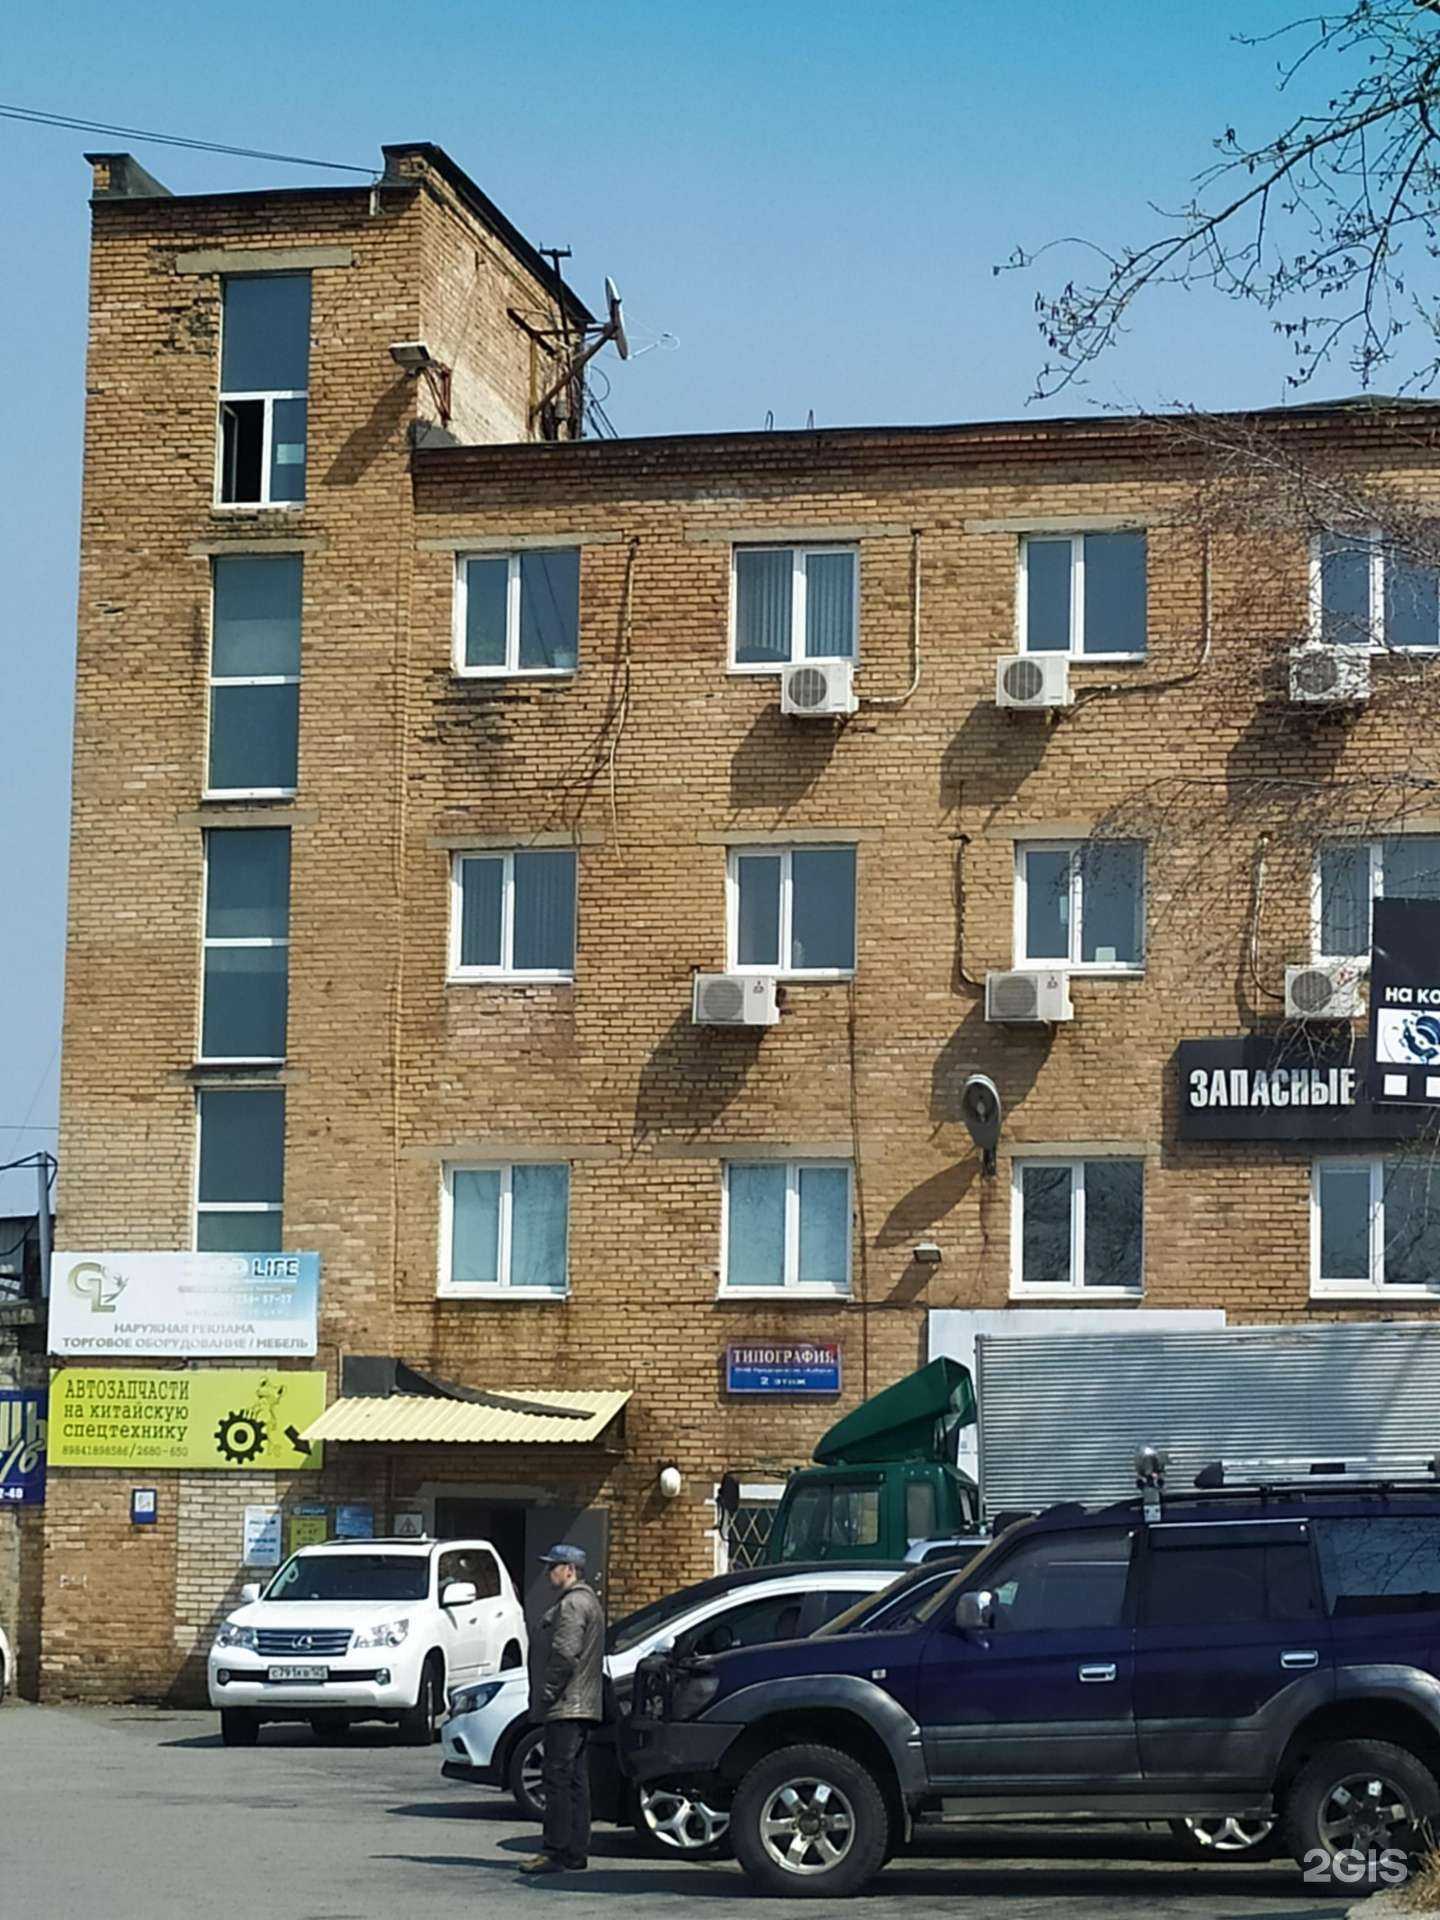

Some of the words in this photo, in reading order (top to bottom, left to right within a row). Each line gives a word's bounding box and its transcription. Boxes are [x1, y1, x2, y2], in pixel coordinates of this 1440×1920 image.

[1385, 986, 1413, 1003] на
[1189, 1067, 1356, 1108] ЗАПАСНЫЕ
[253, 1258, 299, 1277] LIFE
[113, 1323, 188, 1334] НАРУЖНАЯ
[191, 1323, 255, 1335] РЕКЛАМА
[62, 1337, 132, 1349] ТОРГОВОЕ
[135, 1338, 246, 1350] ОБОРУДОВАНИЕ
[256, 1338, 309, 1349] МЕБЕЛЬ
[733, 1349, 835, 1364] ТИПОГРАФИЯ
[64, 1379, 190, 1400] АВТОЗАПЧАСТИ
[64, 1403, 84, 1418] на
[90, 1401, 189, 1423] китайскую
[62, 1423, 188, 1442] спецтехнику
